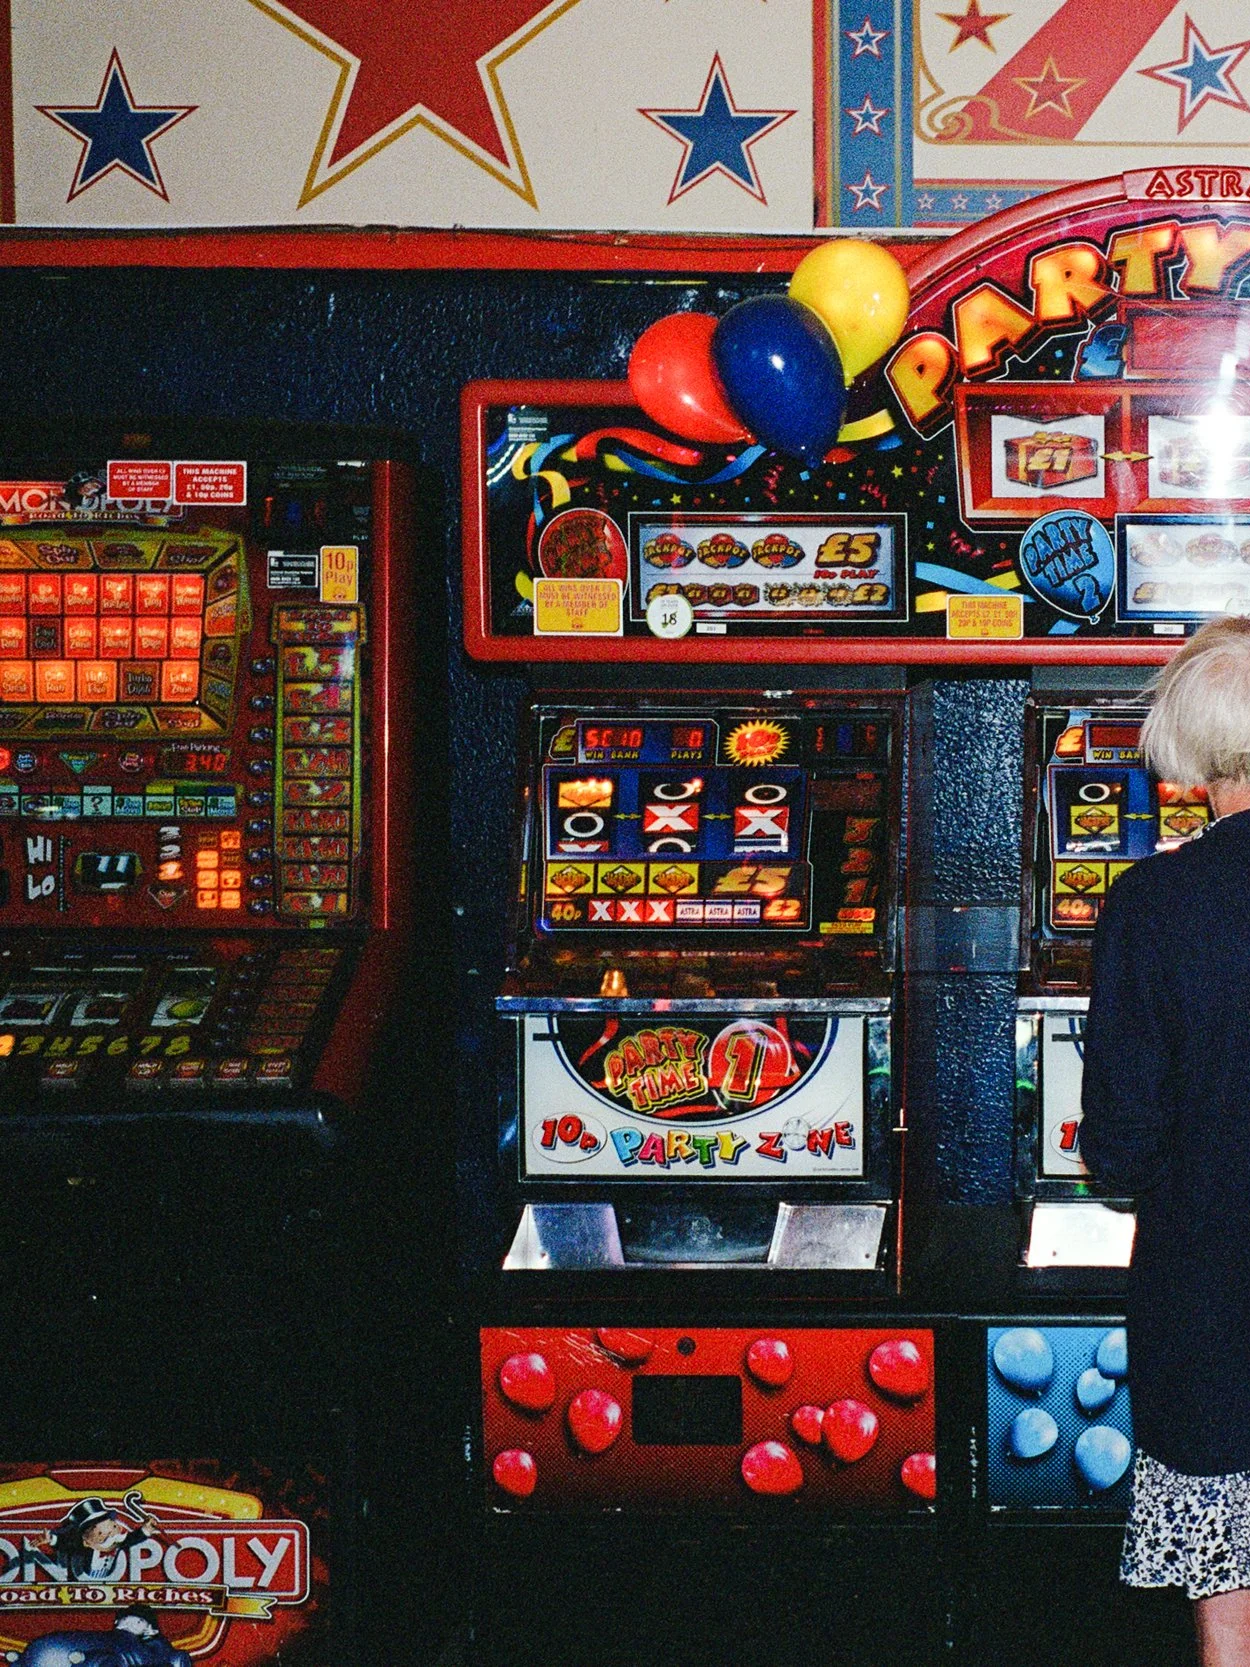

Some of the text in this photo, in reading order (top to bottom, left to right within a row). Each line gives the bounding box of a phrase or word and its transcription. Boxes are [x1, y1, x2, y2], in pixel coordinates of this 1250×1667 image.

[644, 532, 881, 568] JACKPOT JACKPOT JACKPOT £5
[1024, 516, 1093, 577] PARTY
[326, 552, 354, 571] 10p
[1043, 543, 1099, 587] TIME
[325, 571, 352, 585] Play
[840, 569, 880, 579] PLAY
[574, 592, 617, 600] WITNESSED
[852, 583, 890, 605] £2
[1073, 573, 1102, 613] 2
[662, 612, 678, 626] 18
[585, 751, 640, 760] WIN BANK
[671, 751, 703, 760] PLAYS
[1094, 751, 1113, 760] WIN
[27, 835, 52, 864] HI
[28, 874, 55, 900] LO
[713, 866, 792, 897] £5
[552, 900, 801, 921] 40p ASTRA ASTRA ASTRA £2
[107, 1036, 128, 1055] 6
[164, 1036, 191, 1056] 8
[604, 1026, 710, 1095] PARTY
[720, 1028, 768, 1102] 1
[628, 1061, 709, 1113] TIME
[539, 1114, 602, 1153] 10p
[610, 1127, 749, 1170] PARTY
[65, 1587, 106, 1602] To
[116, 1587, 214, 1604] Riches
